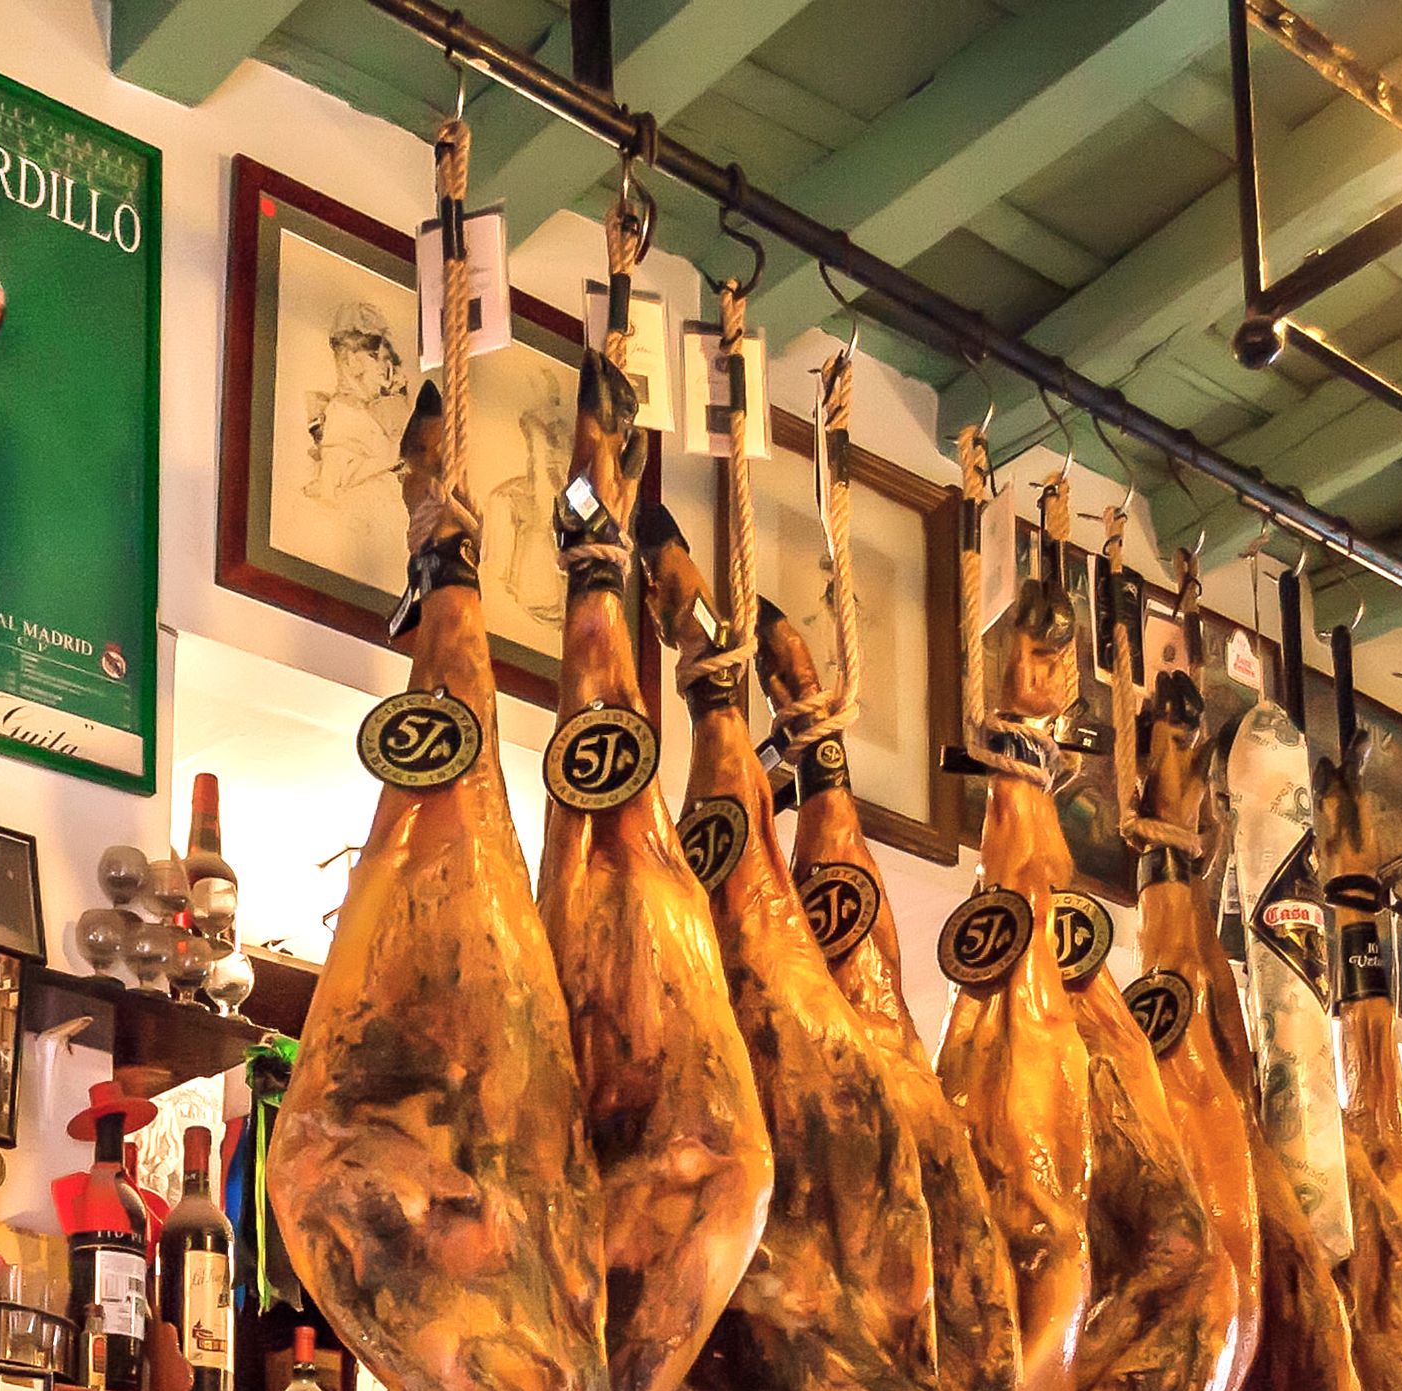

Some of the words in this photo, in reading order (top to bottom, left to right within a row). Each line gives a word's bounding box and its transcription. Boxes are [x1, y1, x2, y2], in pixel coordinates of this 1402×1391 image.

[22, 620, 93, 657] MADRID
[387, 713, 453, 763] 5J
[572, 731, 623, 789] 5J
[962, 913, 1006, 963] 5J
[1264, 904, 1311, 925] Casa
